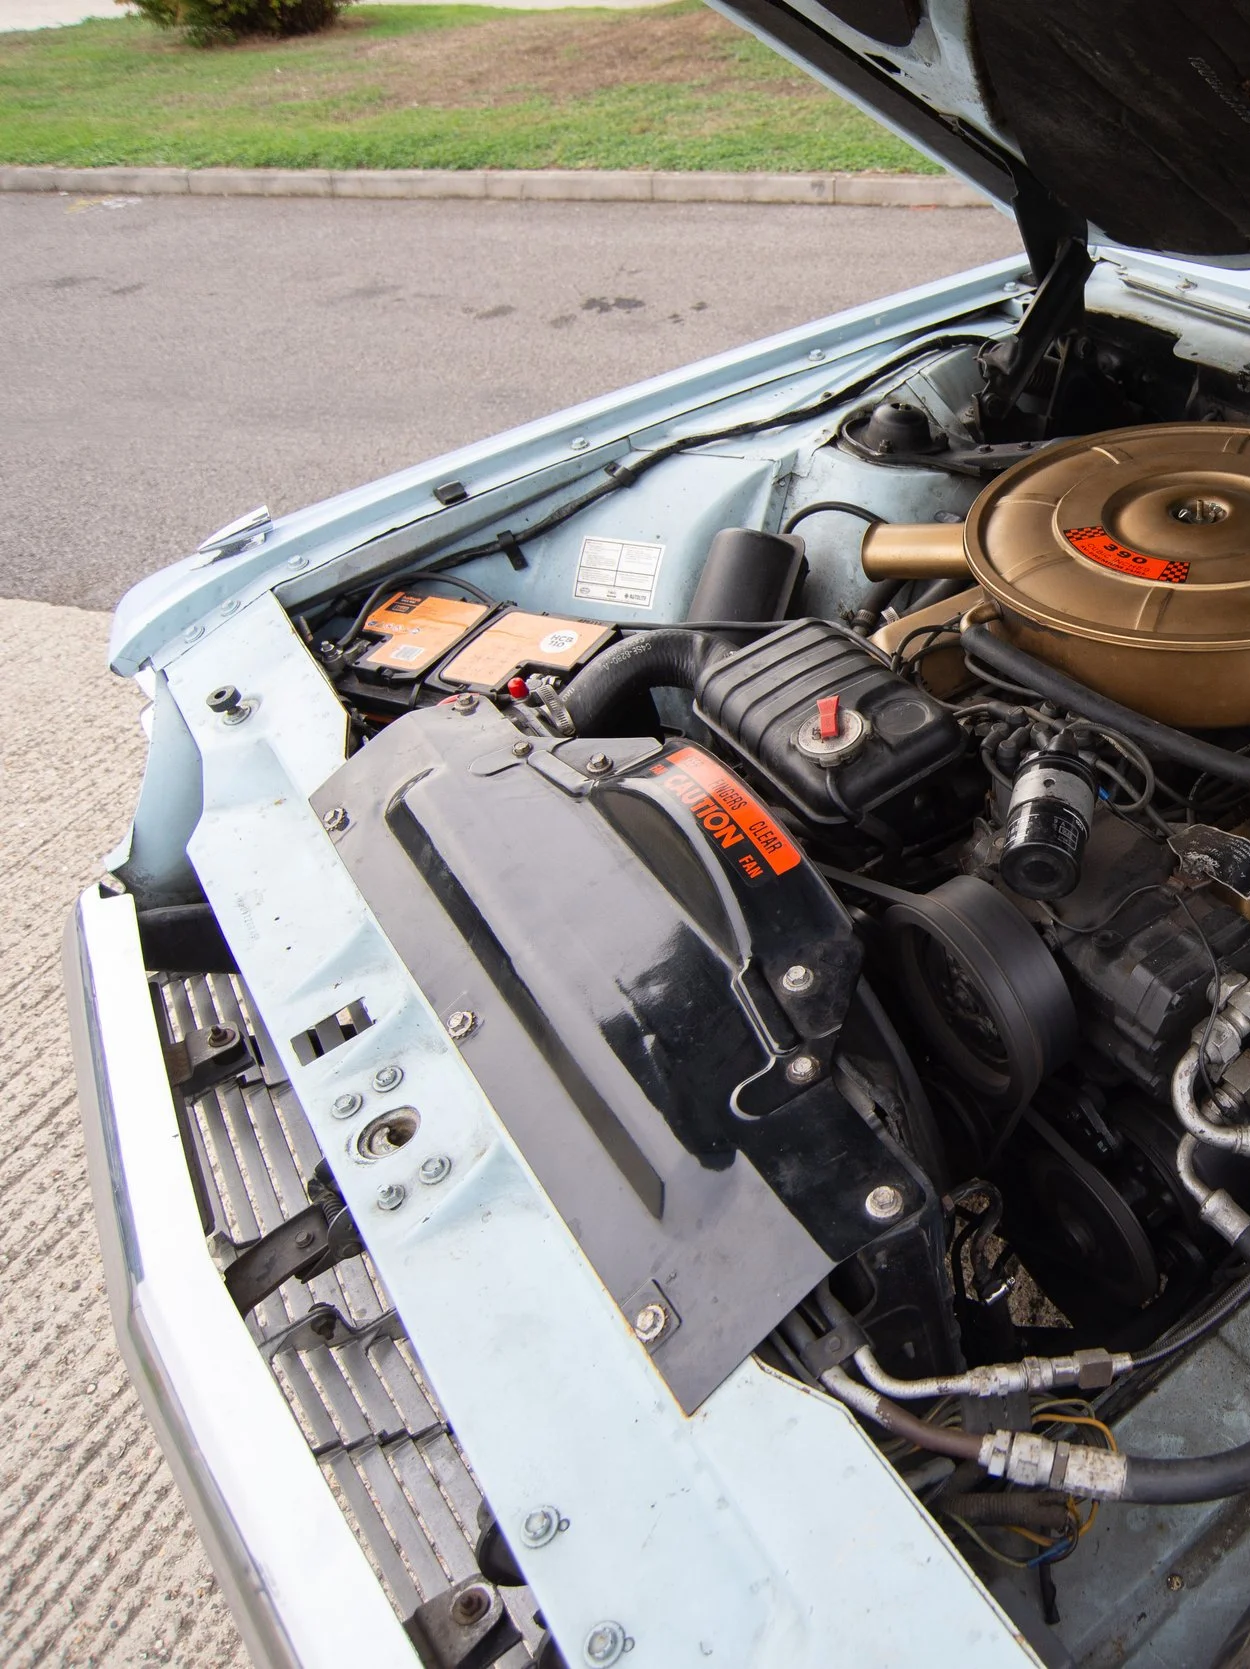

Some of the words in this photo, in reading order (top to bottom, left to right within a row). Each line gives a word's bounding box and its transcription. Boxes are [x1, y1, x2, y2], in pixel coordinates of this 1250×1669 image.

[1087, 543, 1112, 558] CUBIC
[1112, 558, 1151, 572] INCHES
[1103, 544, 1148, 564] 390
[550, 634, 574, 643] HCB
[664, 774, 744, 849] CAUTION
[709, 778, 748, 811] FINGERS
[749, 820, 783, 855] CLEAR
[738, 854, 764, 879] FAN
